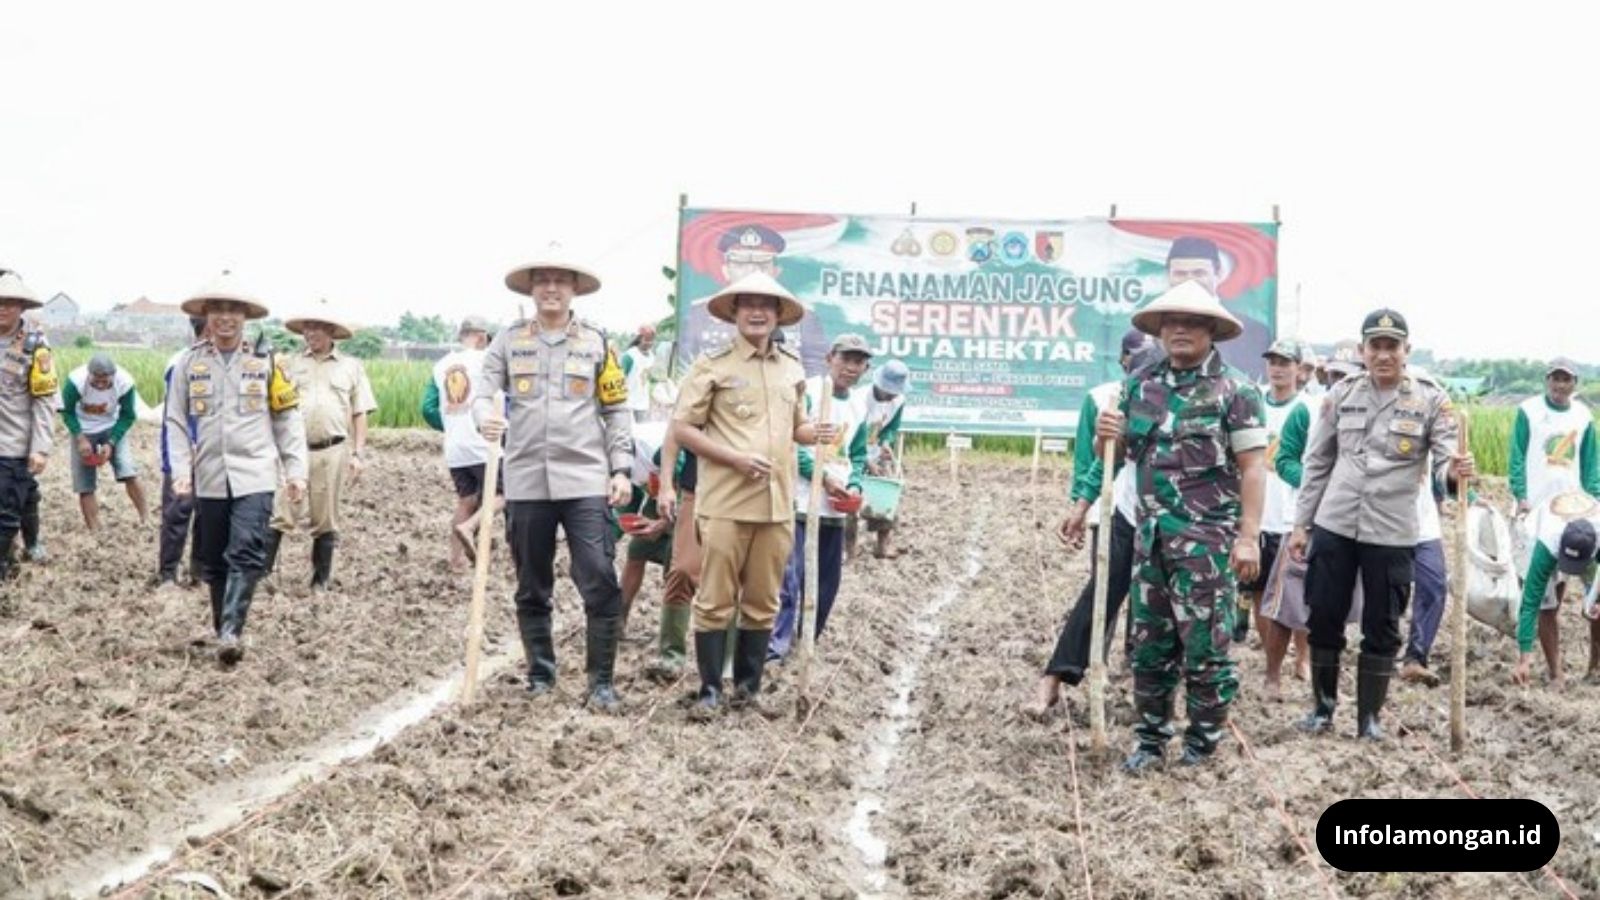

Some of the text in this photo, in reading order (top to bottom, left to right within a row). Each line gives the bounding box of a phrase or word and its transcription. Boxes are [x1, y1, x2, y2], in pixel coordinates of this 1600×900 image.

[821, 269, 1144, 304] PENANAMAN JAGUNG
[871, 302, 1078, 338] SERENTAK
[871, 336, 1096, 363] JUTA HEKTAR
